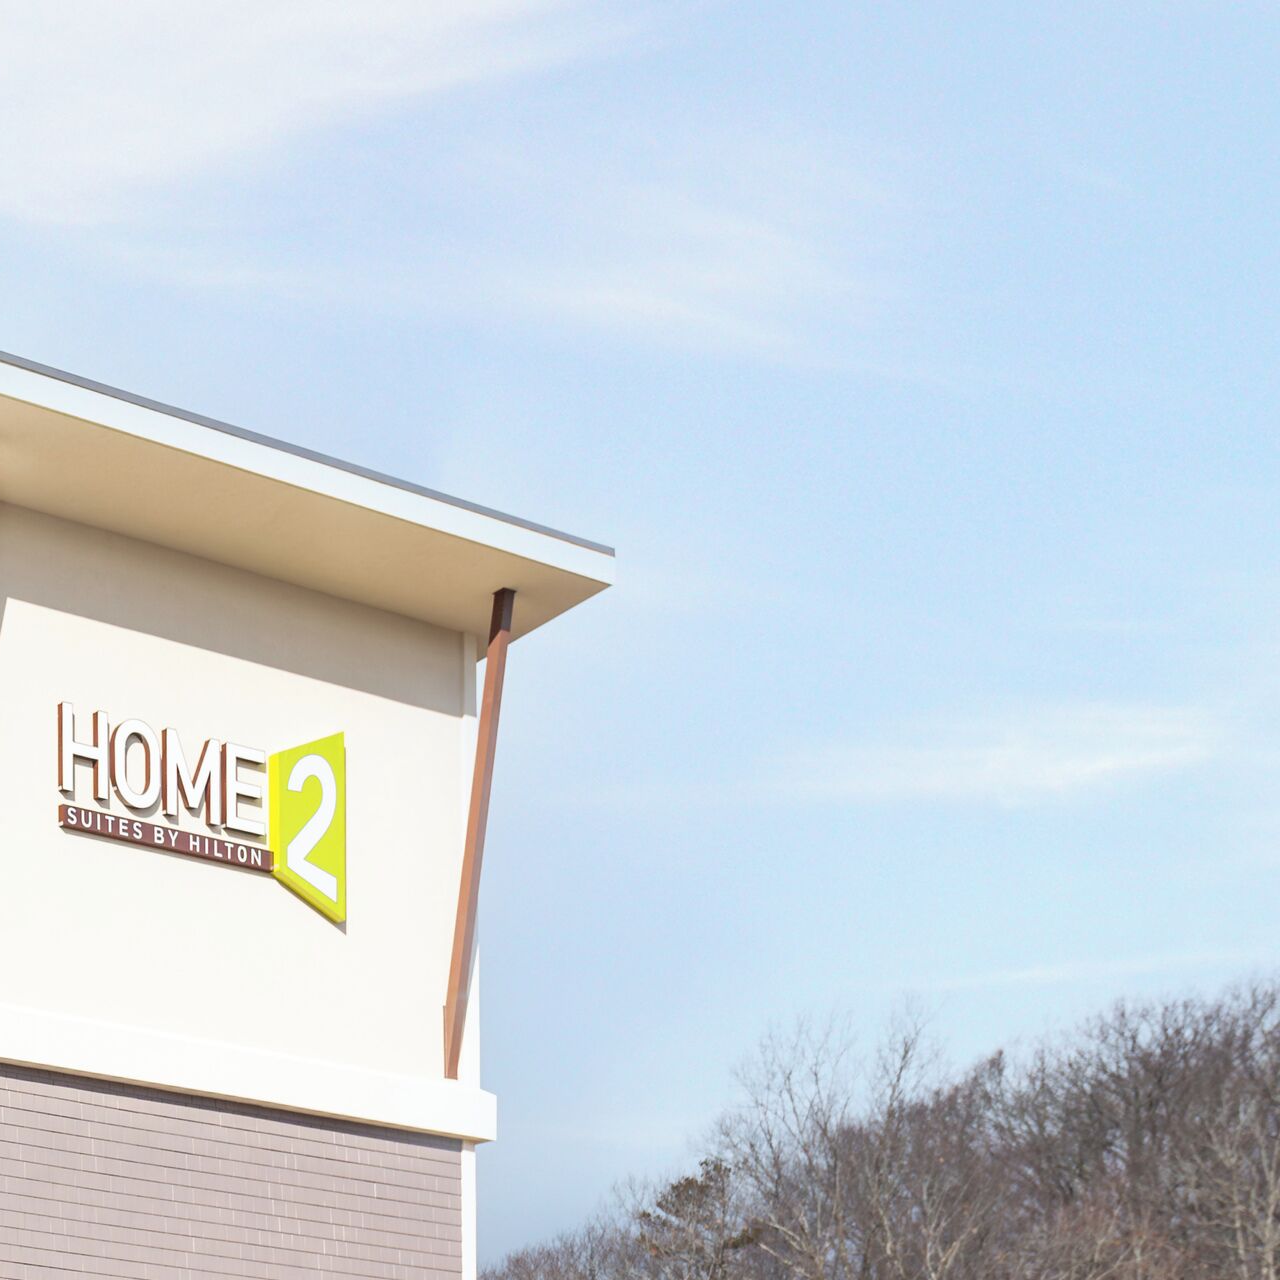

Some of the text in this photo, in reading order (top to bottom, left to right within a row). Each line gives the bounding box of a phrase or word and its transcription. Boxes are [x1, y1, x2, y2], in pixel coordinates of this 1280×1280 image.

[58, 702, 338, 903] HOME 2
[66, 807, 263, 867] SUITES BY HILTON
